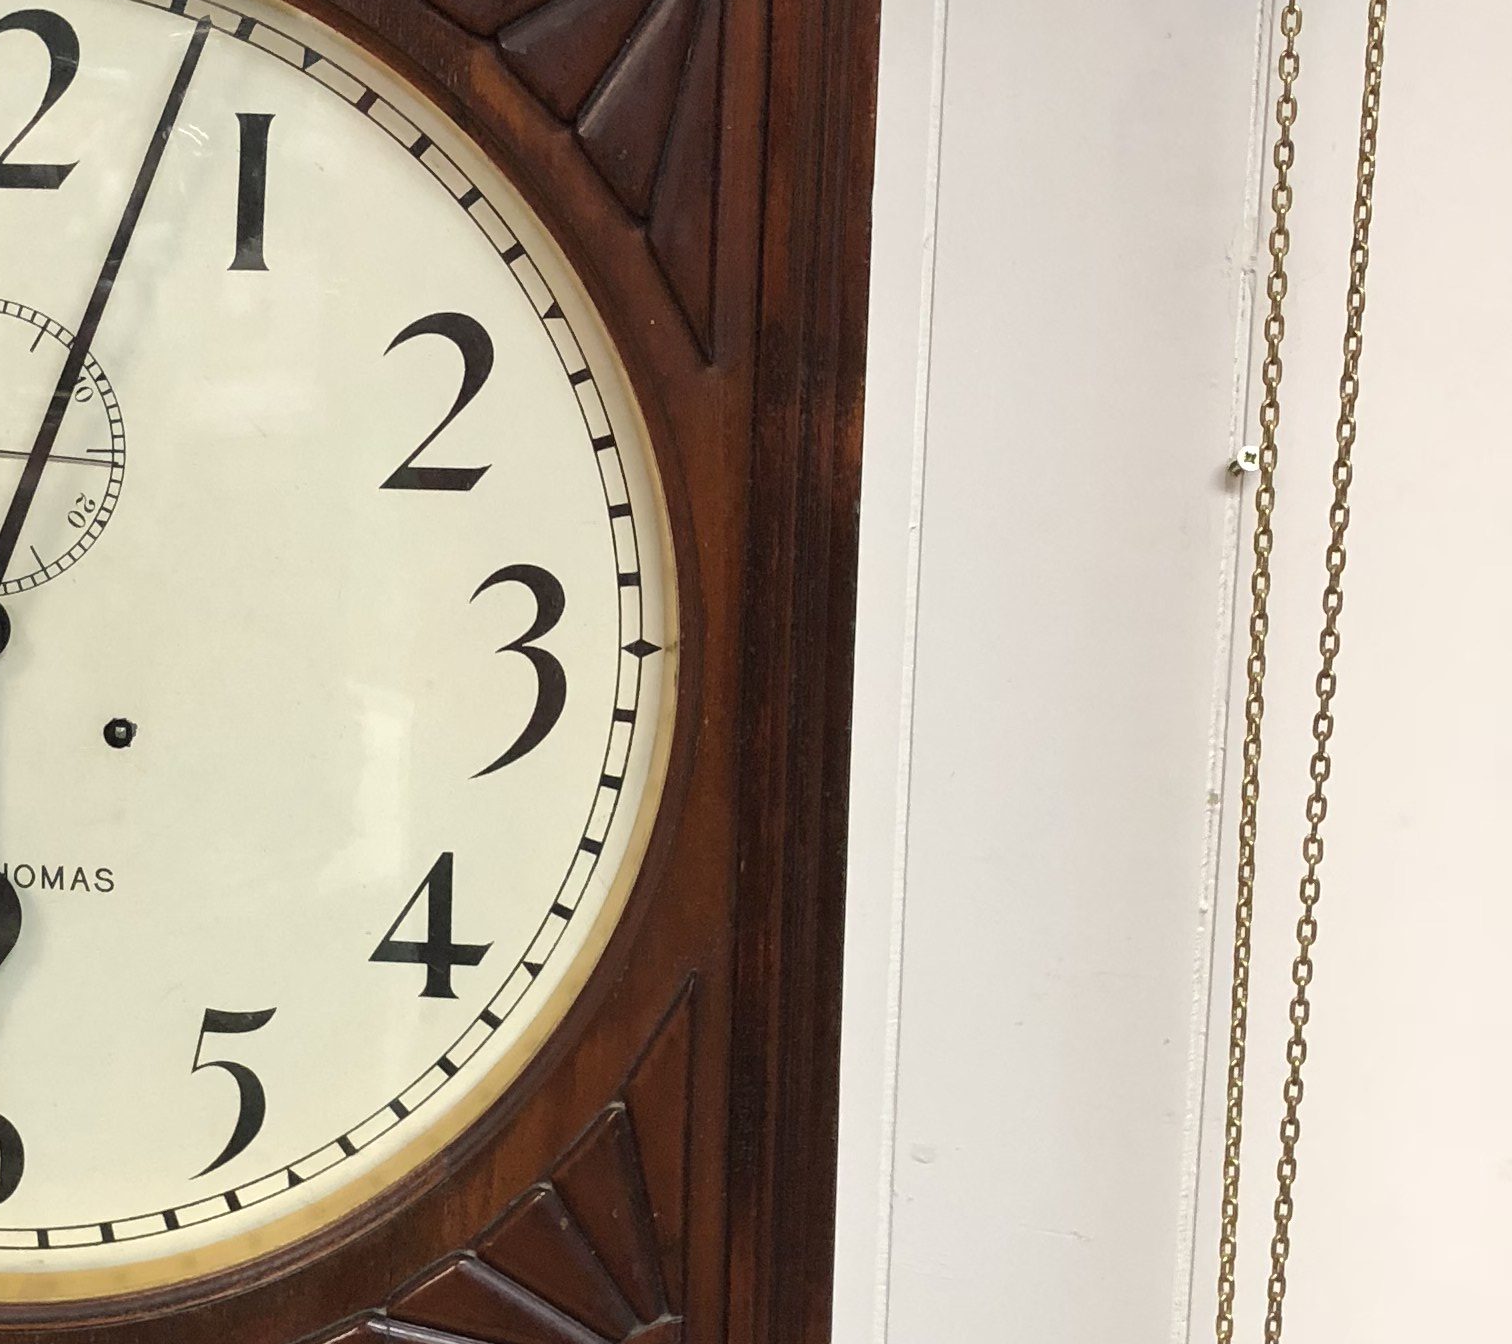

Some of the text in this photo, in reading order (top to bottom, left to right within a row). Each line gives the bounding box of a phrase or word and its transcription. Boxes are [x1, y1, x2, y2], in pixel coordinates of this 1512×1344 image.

[229, 112, 276, 271] 1
[379, 311, 496, 492] 2
[66, 491, 97, 530] 20
[469, 562, 568, 779] 3
[367, 850, 493, 1000] 4
[188, 1006, 278, 1180] 5
